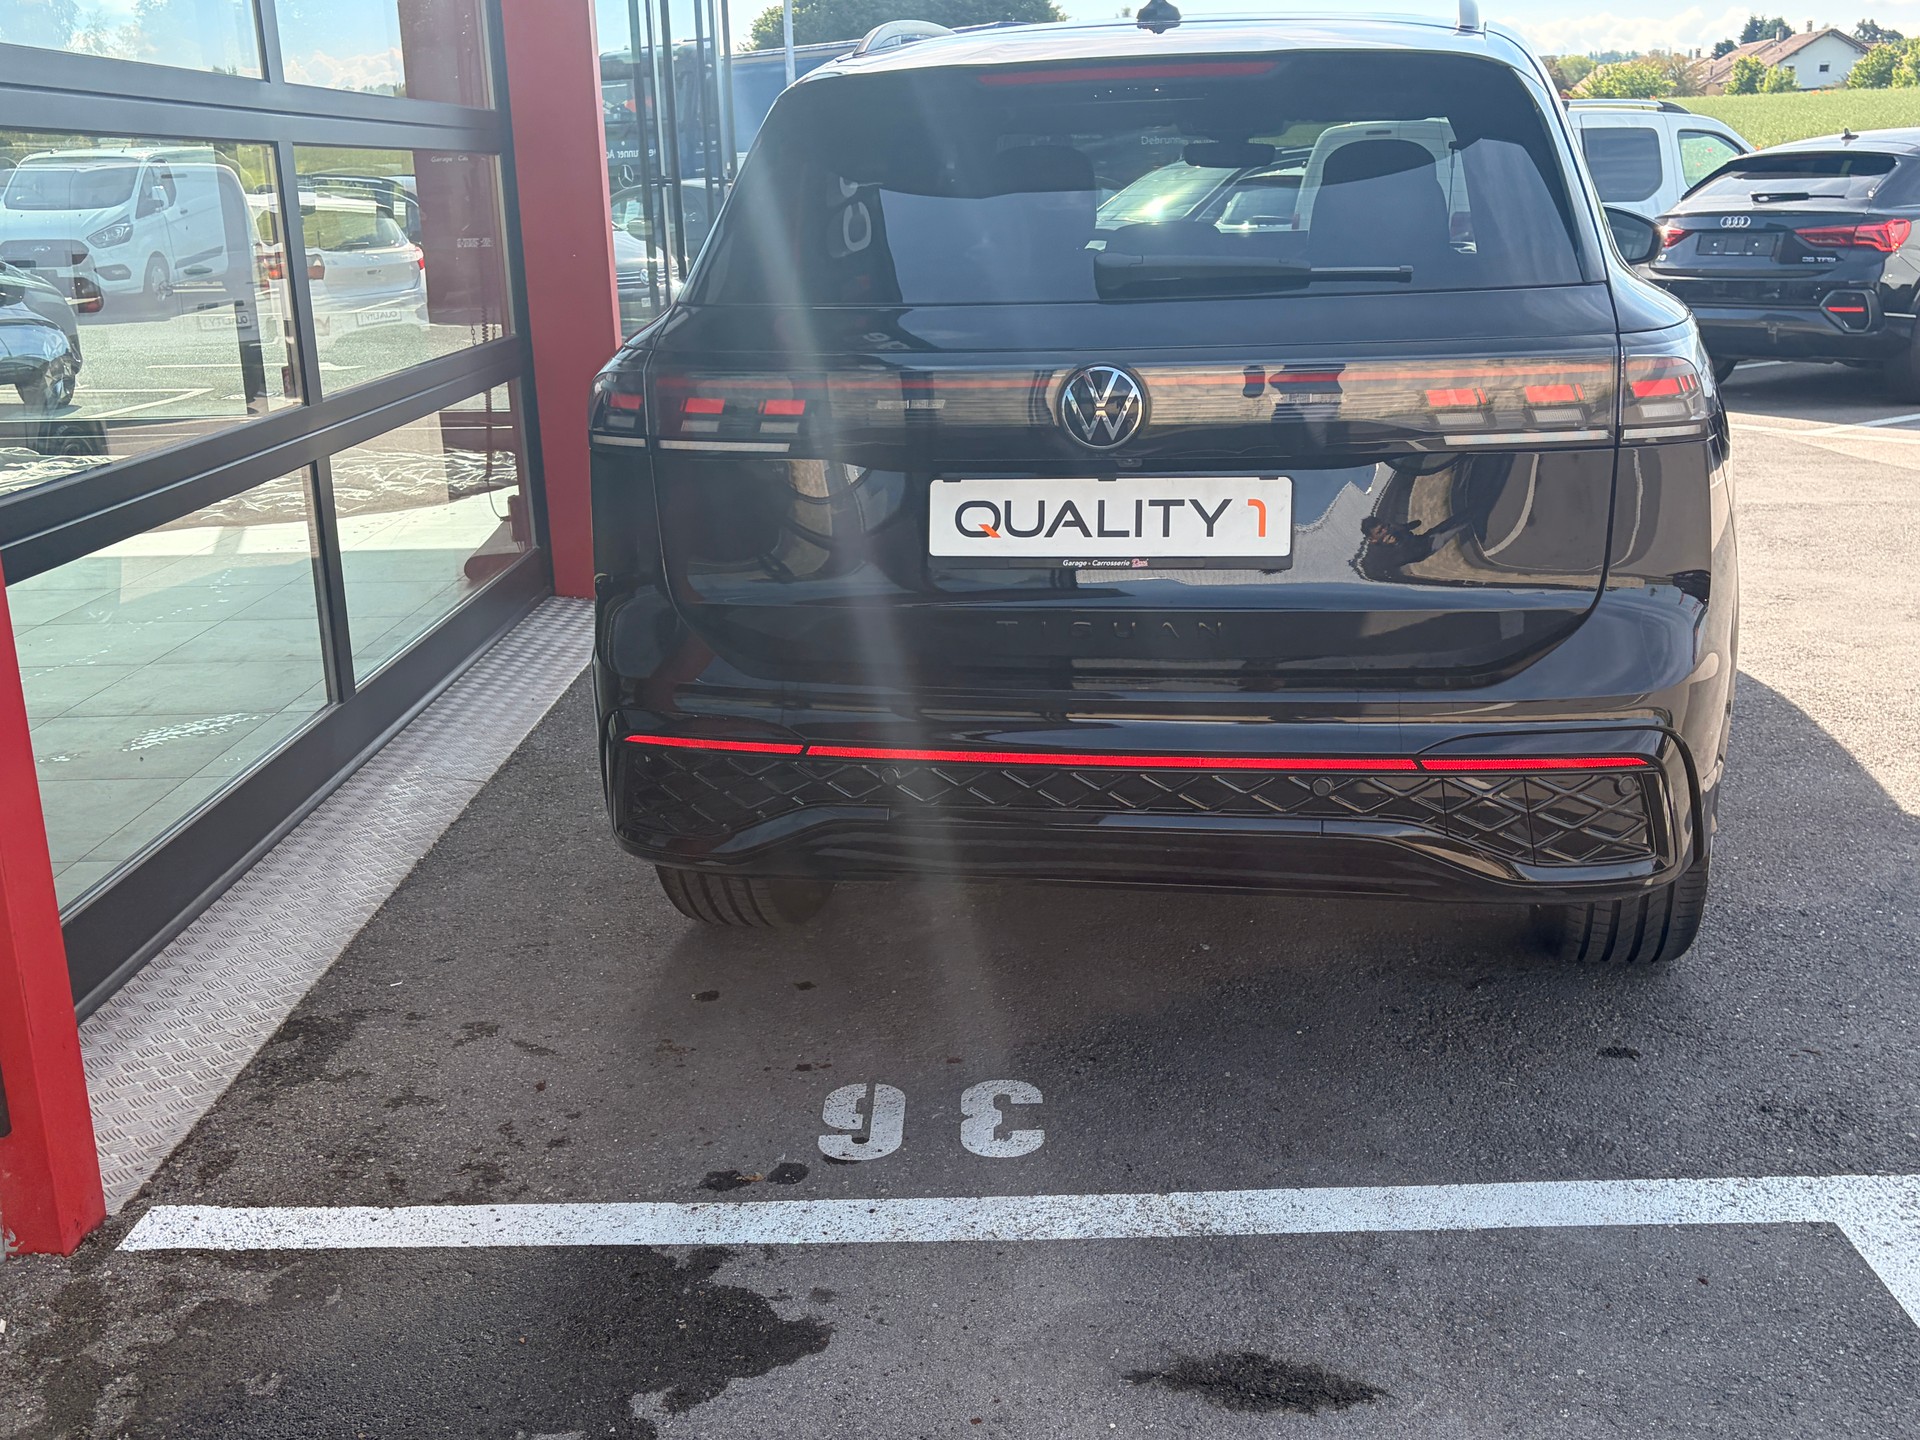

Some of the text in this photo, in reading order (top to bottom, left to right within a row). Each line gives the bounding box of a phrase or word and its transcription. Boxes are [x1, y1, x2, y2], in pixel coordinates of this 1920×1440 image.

[955, 499, 1266, 538] QUALITY 1
[1063, 559, 1087, 568] Garage
[996, 621, 1221, 638] TIGUAN
